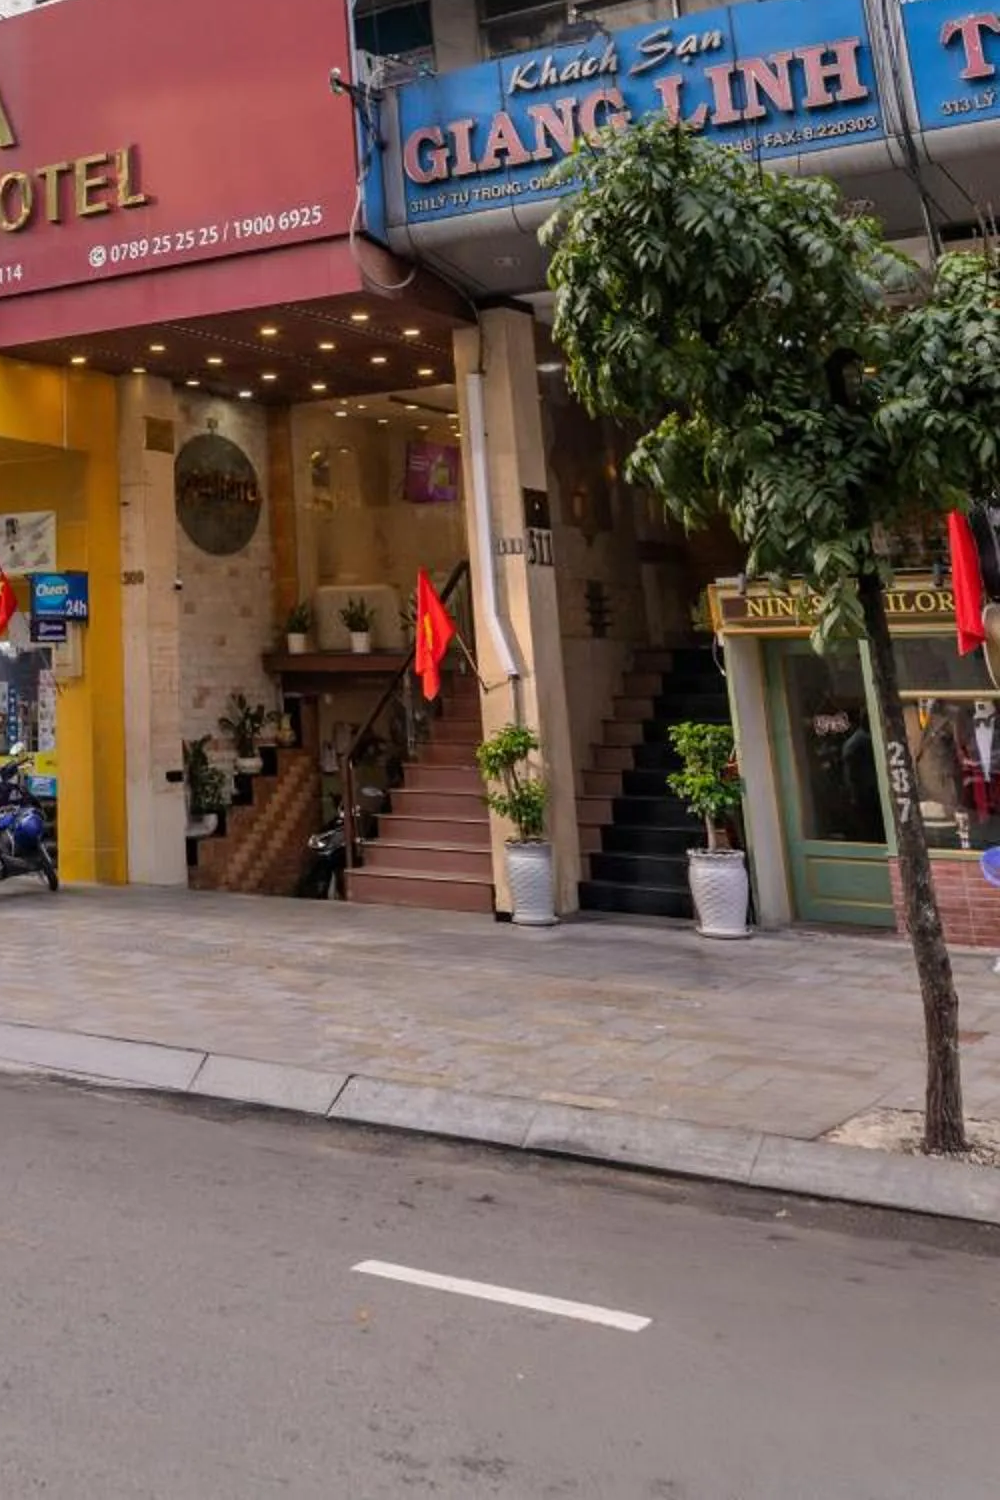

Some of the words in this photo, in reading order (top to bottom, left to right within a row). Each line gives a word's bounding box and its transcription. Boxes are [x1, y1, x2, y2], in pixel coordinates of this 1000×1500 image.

[507, 40, 619, 96] Khách
[628, 26, 724, 77] Sạn
[403, 88, 632, 184] GIANG
[654, 36, 869, 130] LINH
[110, 239, 149, 263] 0789
[152, 235, 172, 256] 25
[175, 231, 195, 252] 25
[199, 225, 219, 246] 25
[233, 214, 275, 238] 1900
[278, 204, 323, 231] 6925
[66, 598, 87, 617] 24h
[888, 741, 913, 823] 287
